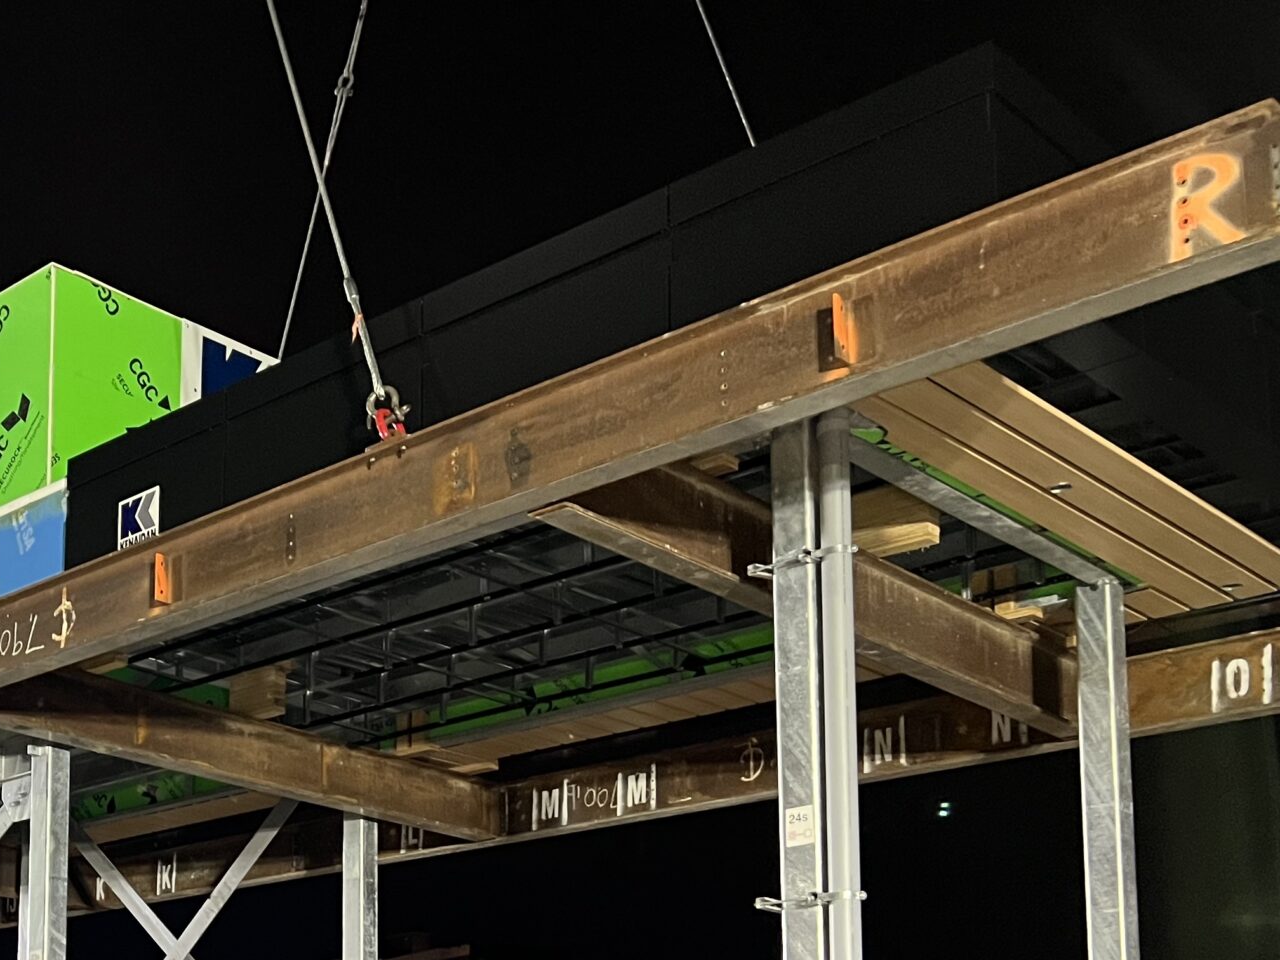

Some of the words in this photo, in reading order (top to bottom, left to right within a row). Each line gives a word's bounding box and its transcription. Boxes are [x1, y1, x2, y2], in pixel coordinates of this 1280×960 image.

[1169, 153, 1248, 263] R
[91, 281, 119, 315] CG
[129, 358, 158, 402] CGC
[788, 812, 809, 825] 245
